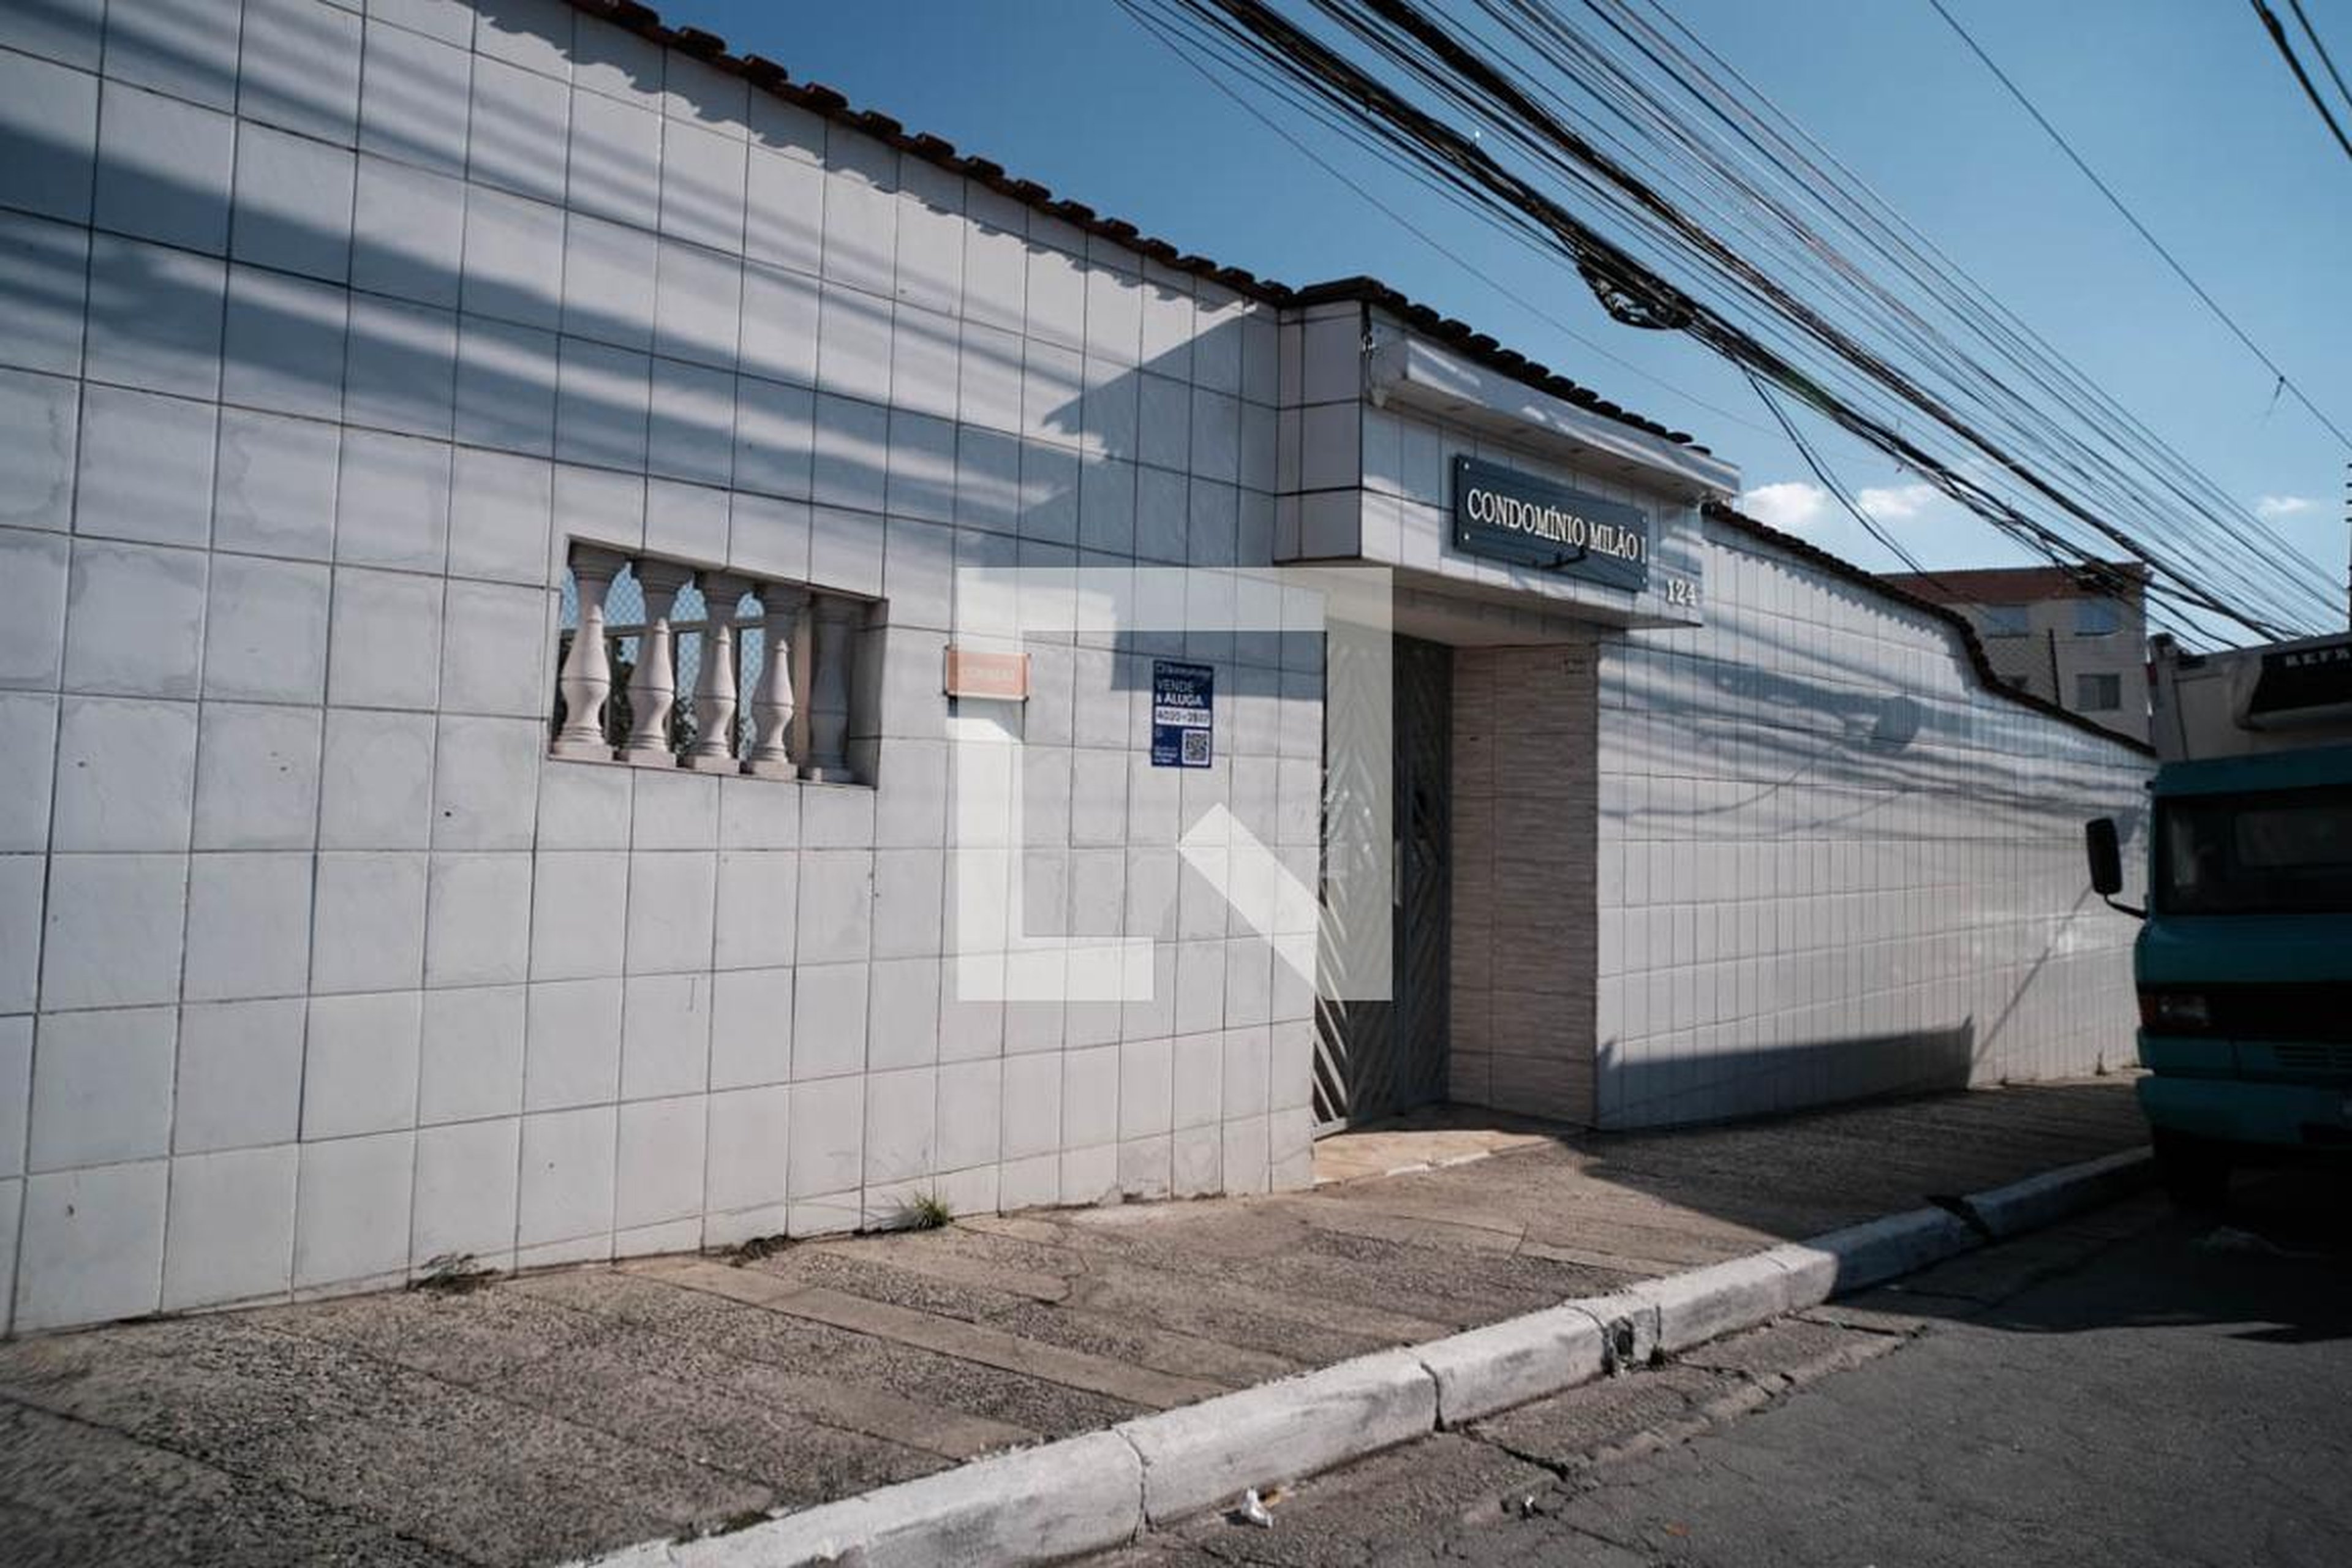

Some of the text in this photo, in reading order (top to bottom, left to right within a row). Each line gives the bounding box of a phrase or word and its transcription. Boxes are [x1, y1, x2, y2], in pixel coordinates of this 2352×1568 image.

[1467, 488, 1586, 547] CONDOMÍNIO
[1591, 521, 1638, 560] MILÃO
[1667, 578, 1697, 606] 124
[1156, 679, 1193, 693] VENDE
[1164, 693, 1204, 706] ALUGA
